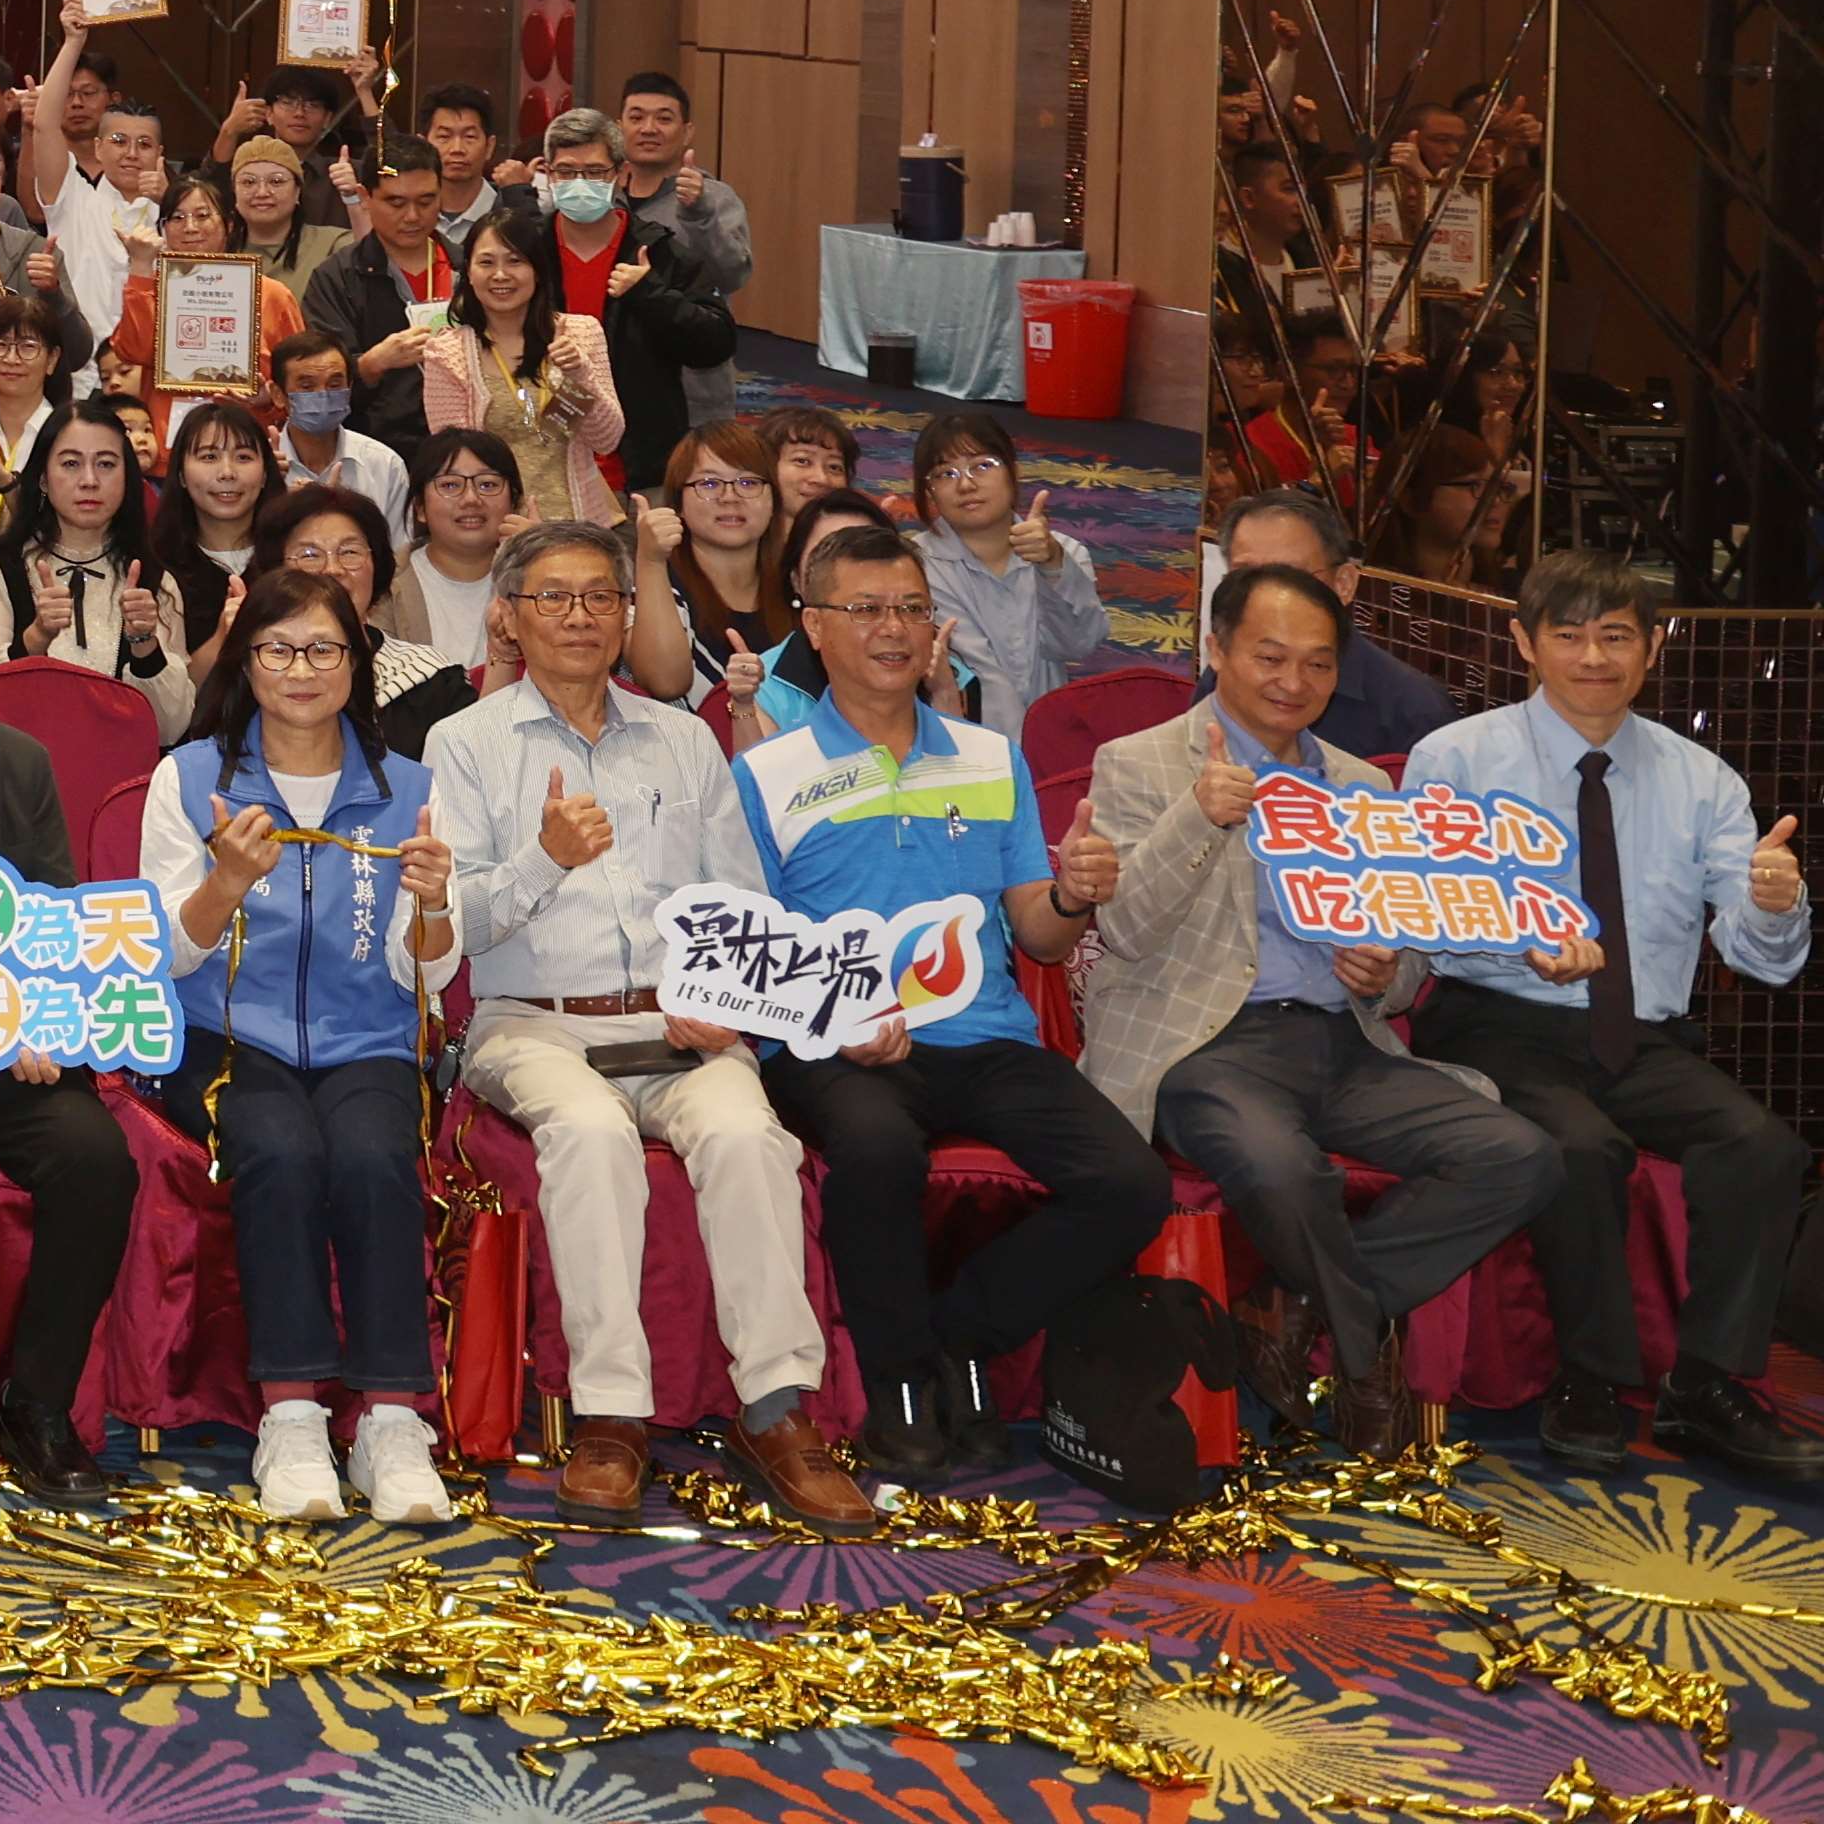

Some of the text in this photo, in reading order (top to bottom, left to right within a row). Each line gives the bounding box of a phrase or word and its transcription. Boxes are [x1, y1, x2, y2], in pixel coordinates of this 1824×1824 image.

[1254, 776, 1564, 864] 食在安心
[1285, 872, 1584, 941] 吃得開心
[677, 982, 804, 1024] It's Our Time
